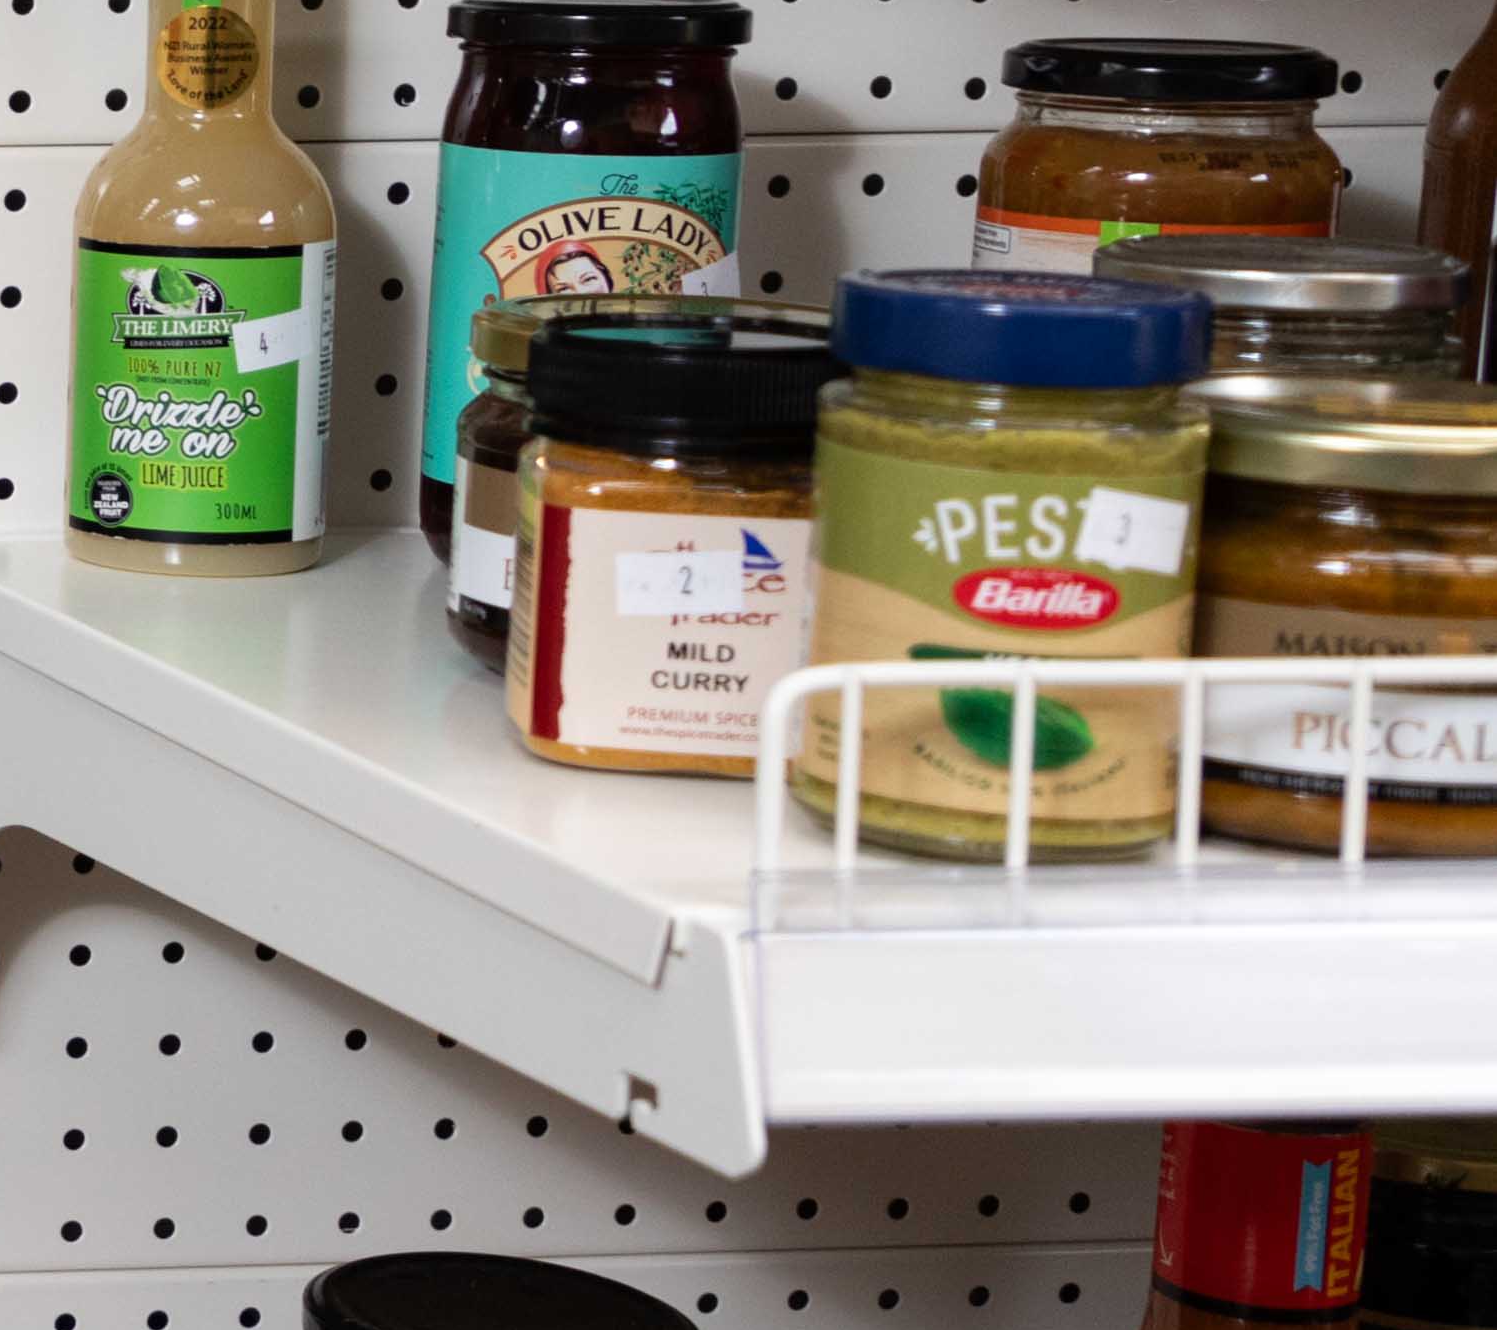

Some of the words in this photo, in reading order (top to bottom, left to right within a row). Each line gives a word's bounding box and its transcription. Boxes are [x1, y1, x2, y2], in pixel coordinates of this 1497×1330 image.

[189, 17, 228, 30] 2022
[599, 173, 639, 196] The
[517, 206, 621, 253] OLIVE
[631, 207, 711, 257] LADY
[122, 319, 158, 336] THE
[162, 319, 233, 336] LIMERY
[259, 332, 269, 355] 4
[128, 356, 160, 374] 100%
[165, 357, 198, 377] PURE
[204, 360, 223, 377] NZ
[101, 383, 247, 429] Drizzle
[109, 425, 170, 456] me
[181, 428, 237, 459] on
[142, 463, 176, 487] LIME
[180, 465, 224, 489] JUICE
[93, 500, 129, 510] ZEALAND
[101, 493, 119, 501] NEW
[98, 507, 122, 518] FRUIT
[214, 503, 258, 520] 300ML
[934, 493, 1088, 564] PES
[679, 565, 693, 595] 2
[971, 576, 1108, 620] Barilla
[667, 641, 735, 664] MILD
[650, 669, 749, 693] CURRY
[627, 706, 709, 724] PREMIUM
[1327, 1149, 1360, 1298] ITALIAN
